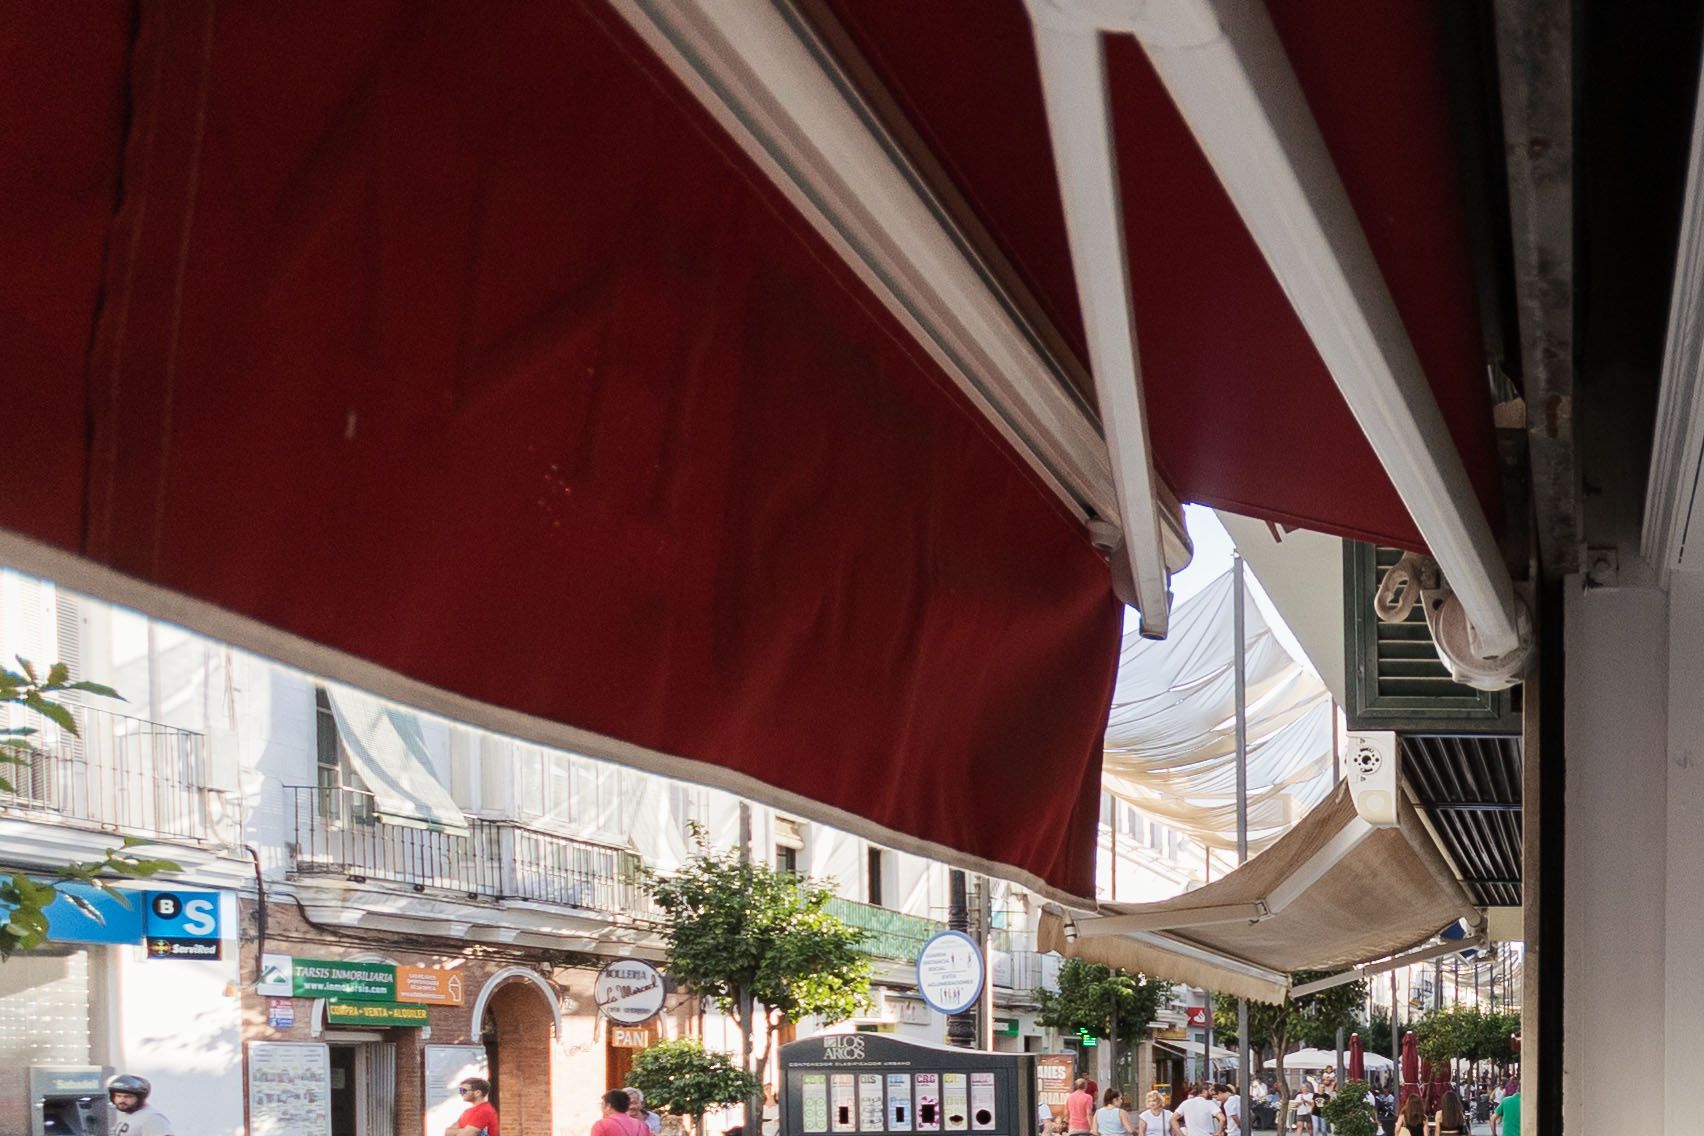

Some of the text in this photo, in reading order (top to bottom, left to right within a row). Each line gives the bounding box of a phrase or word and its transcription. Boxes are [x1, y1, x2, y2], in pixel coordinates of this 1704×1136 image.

[183, 900, 215, 935] S
[172, 943, 217, 955] ServiRed
[296, 966, 330, 979] TARSIS
[331, 968, 393, 983] INMOBILIARIA
[394, 1007, 428, 1019] ALQUILER
[615, 1030, 643, 1047] PAN
[837, 1035, 865, 1047] LOS
[823, 1047, 866, 1060] ARCOS
